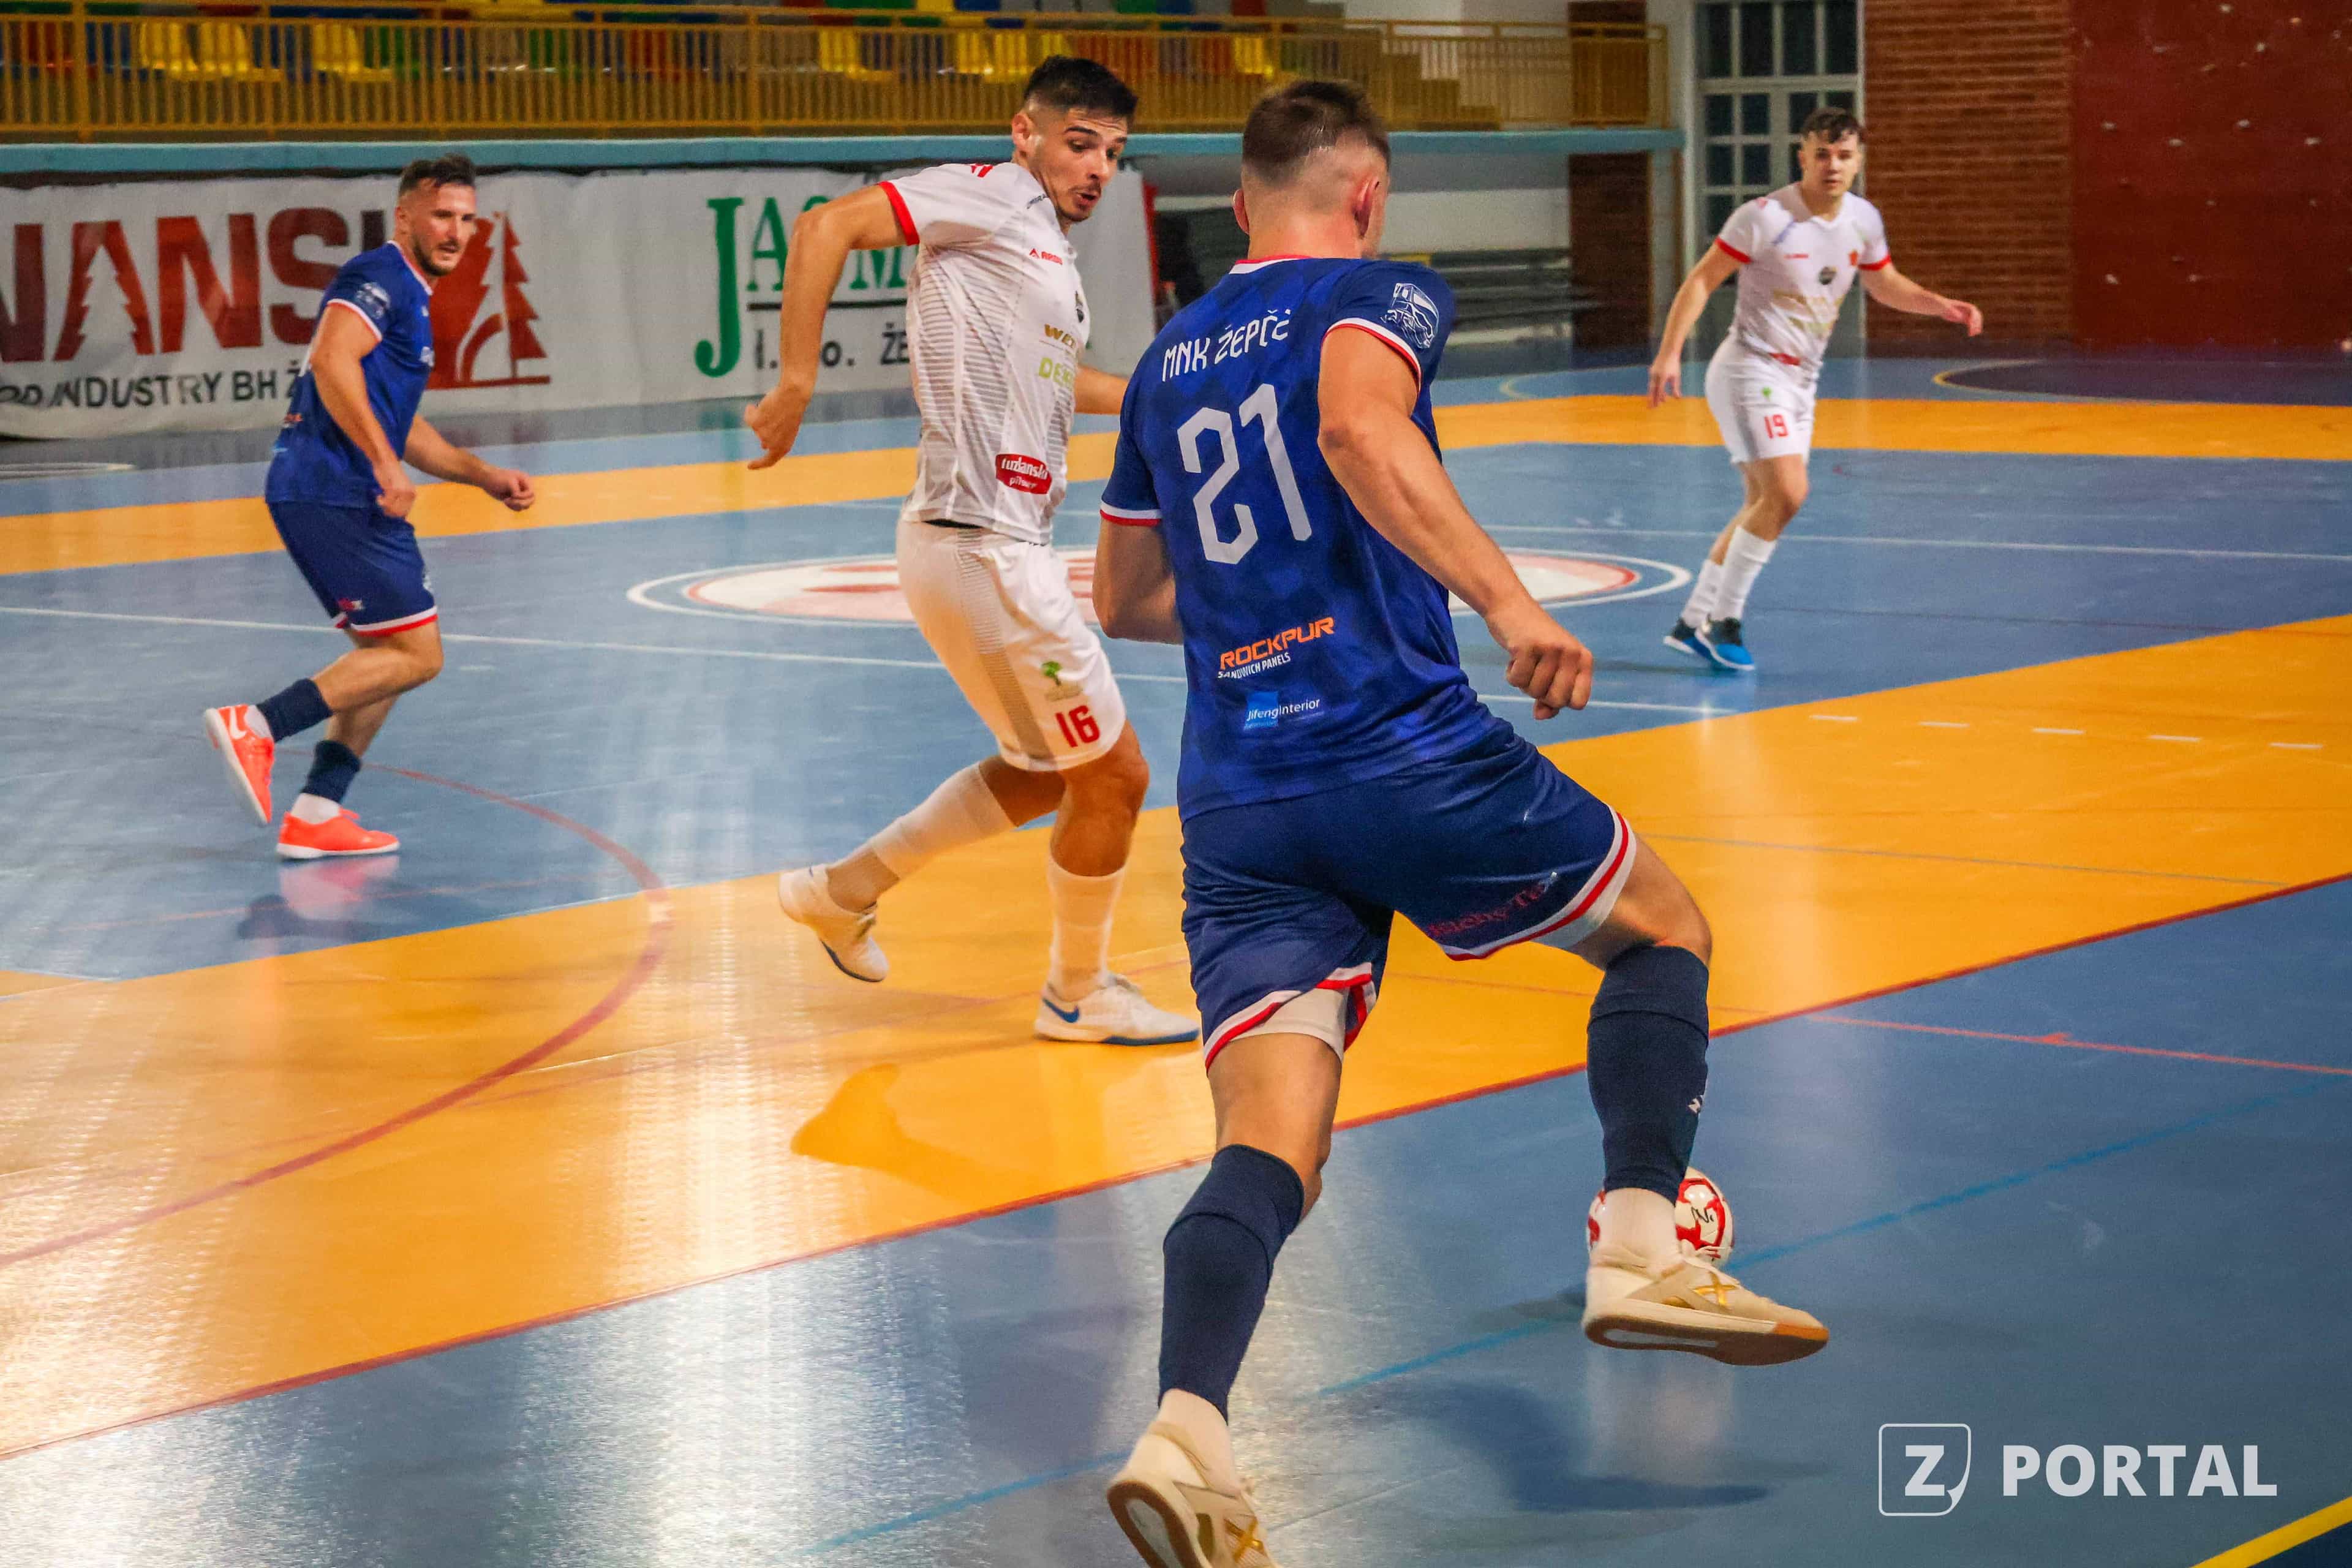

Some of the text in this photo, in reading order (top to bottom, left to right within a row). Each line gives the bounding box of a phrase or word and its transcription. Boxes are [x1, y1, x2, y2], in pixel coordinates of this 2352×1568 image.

[1162, 337, 1210, 382] MNK
[232, 370, 277, 401] BH
[1764, 414, 1788, 439] 19
[1177, 383, 1312, 564] 21
[1220, 617, 1334, 669] ROCKPUR
[1217, 652, 1291, 679] SANDWICH PANELS
[1055, 705, 1100, 747] 16
